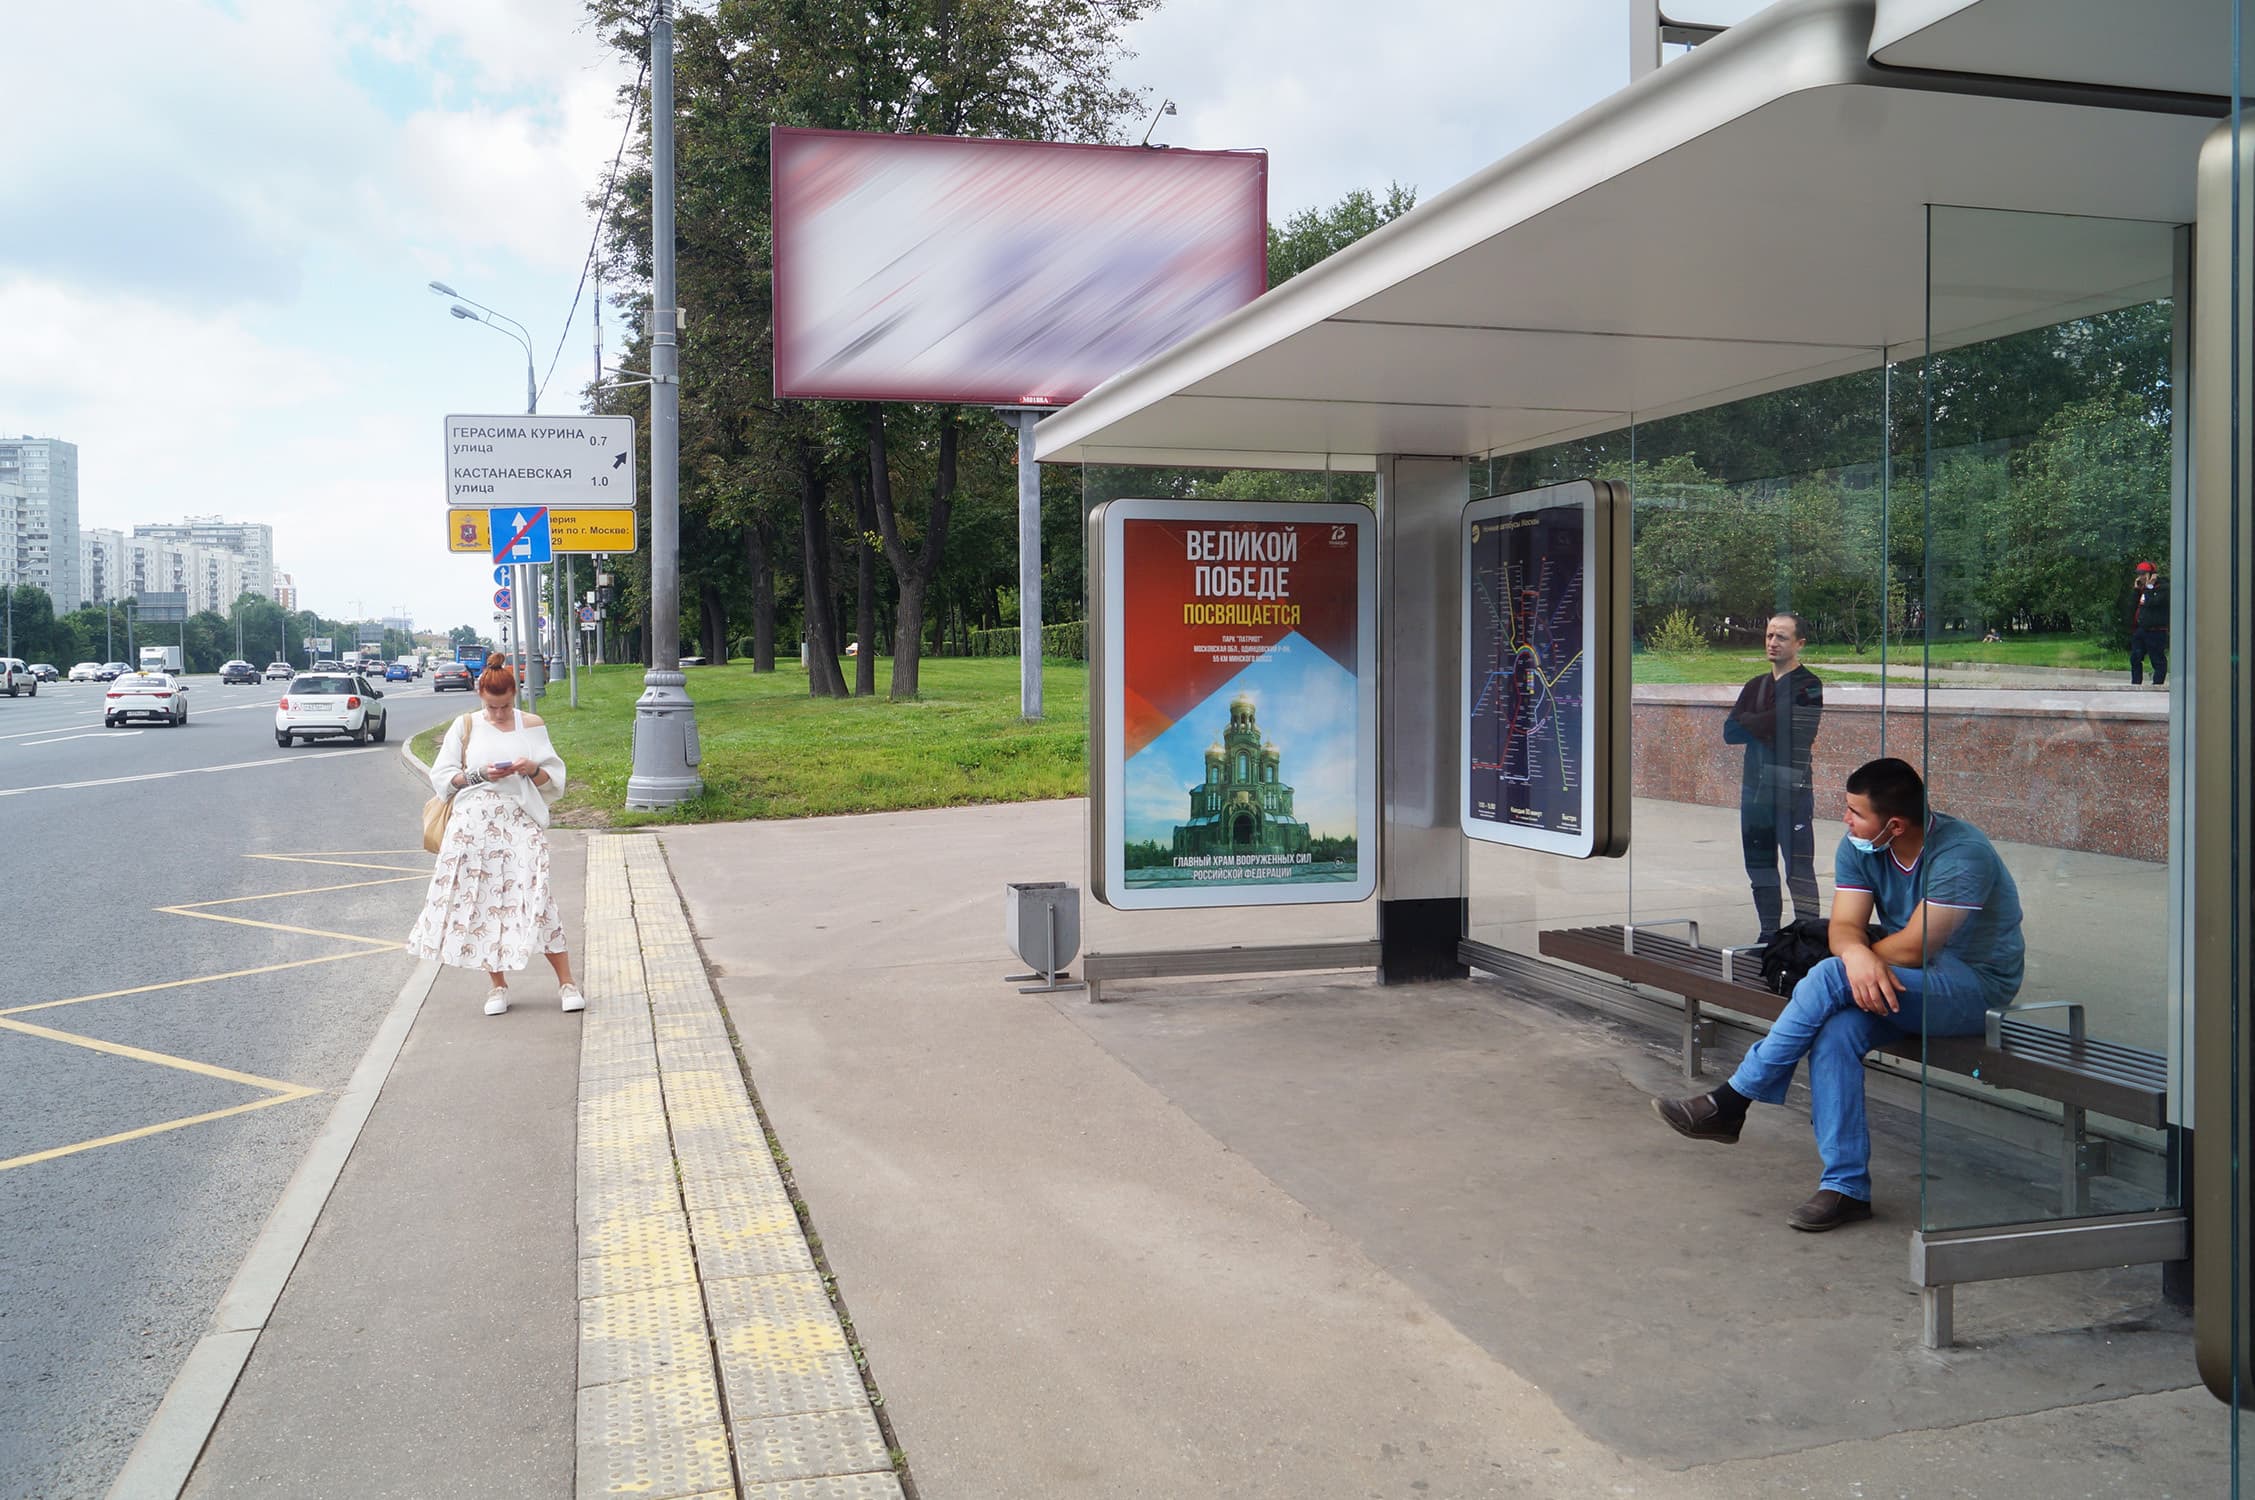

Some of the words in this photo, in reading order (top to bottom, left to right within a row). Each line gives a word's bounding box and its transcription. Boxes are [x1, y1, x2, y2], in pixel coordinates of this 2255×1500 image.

[453, 427, 526, 439] ГЕРАСИМА
[531, 428, 585, 440] КУРИНА
[589, 436, 608, 447] 0.7
[453, 444, 493, 455] улица
[454, 468, 572, 479] КАСТАНАЕВСКАЯ
[591, 476, 609, 487] 1.0
[454, 484, 494, 495] улица
[590, 525, 630, 535] Москве:
[1187, 526, 1297, 562] ВЕЛИКОЙ
[1195, 566, 1289, 600] ПОБЕДЕ
[1183, 604, 1301, 627] ПОСВЯЩАЕТСЯ
[1173, 854, 1211, 867] ГЛАВНЫЙ
[1212, 855, 1235, 866] ХРАМ
[1236, 853, 1295, 866] ВООРУЖЕННЫХ
[1295, 852, 1312, 864] СИЛ
[1193, 868, 1243, 880] РОССИЙСКОЙ
[1244, 867, 1292, 879] ФЕДЕРАЦИИ
